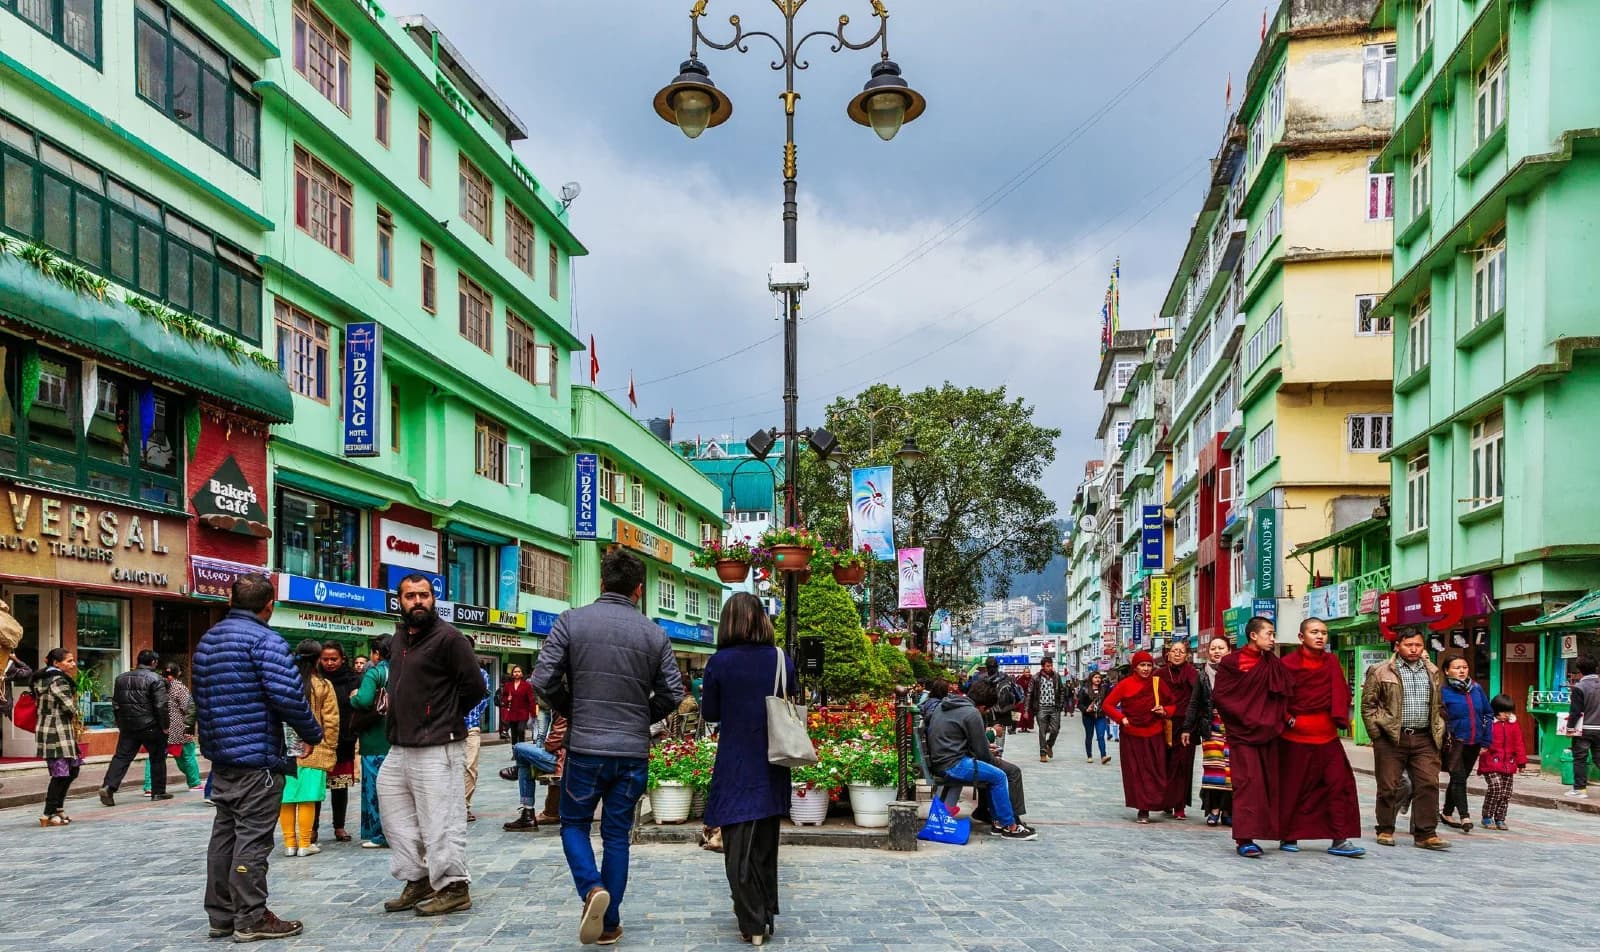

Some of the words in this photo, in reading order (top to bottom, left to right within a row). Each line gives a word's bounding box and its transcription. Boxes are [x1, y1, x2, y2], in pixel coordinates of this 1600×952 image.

[352, 358, 367, 426] DZONG
[348, 429, 368, 437] HOTEL
[209, 478, 257, 504] Baker's
[581, 476, 592, 520] DZONG
[214, 495, 249, 516] Café
[8, 490, 169, 555] VERSAL
[48, 540, 114, 565] TRADERS
[386, 535, 420, 556] Canon
[1262, 530, 1273, 590] WOODLAND
[112, 566, 169, 586] GANGTOK
[1158, 580, 1168, 609] house
[457, 607, 485, 622] SONY
[499, 611, 517, 625] Nikon
[1158, 615, 1168, 632] roll
[480, 632, 521, 647] CONVERSE
